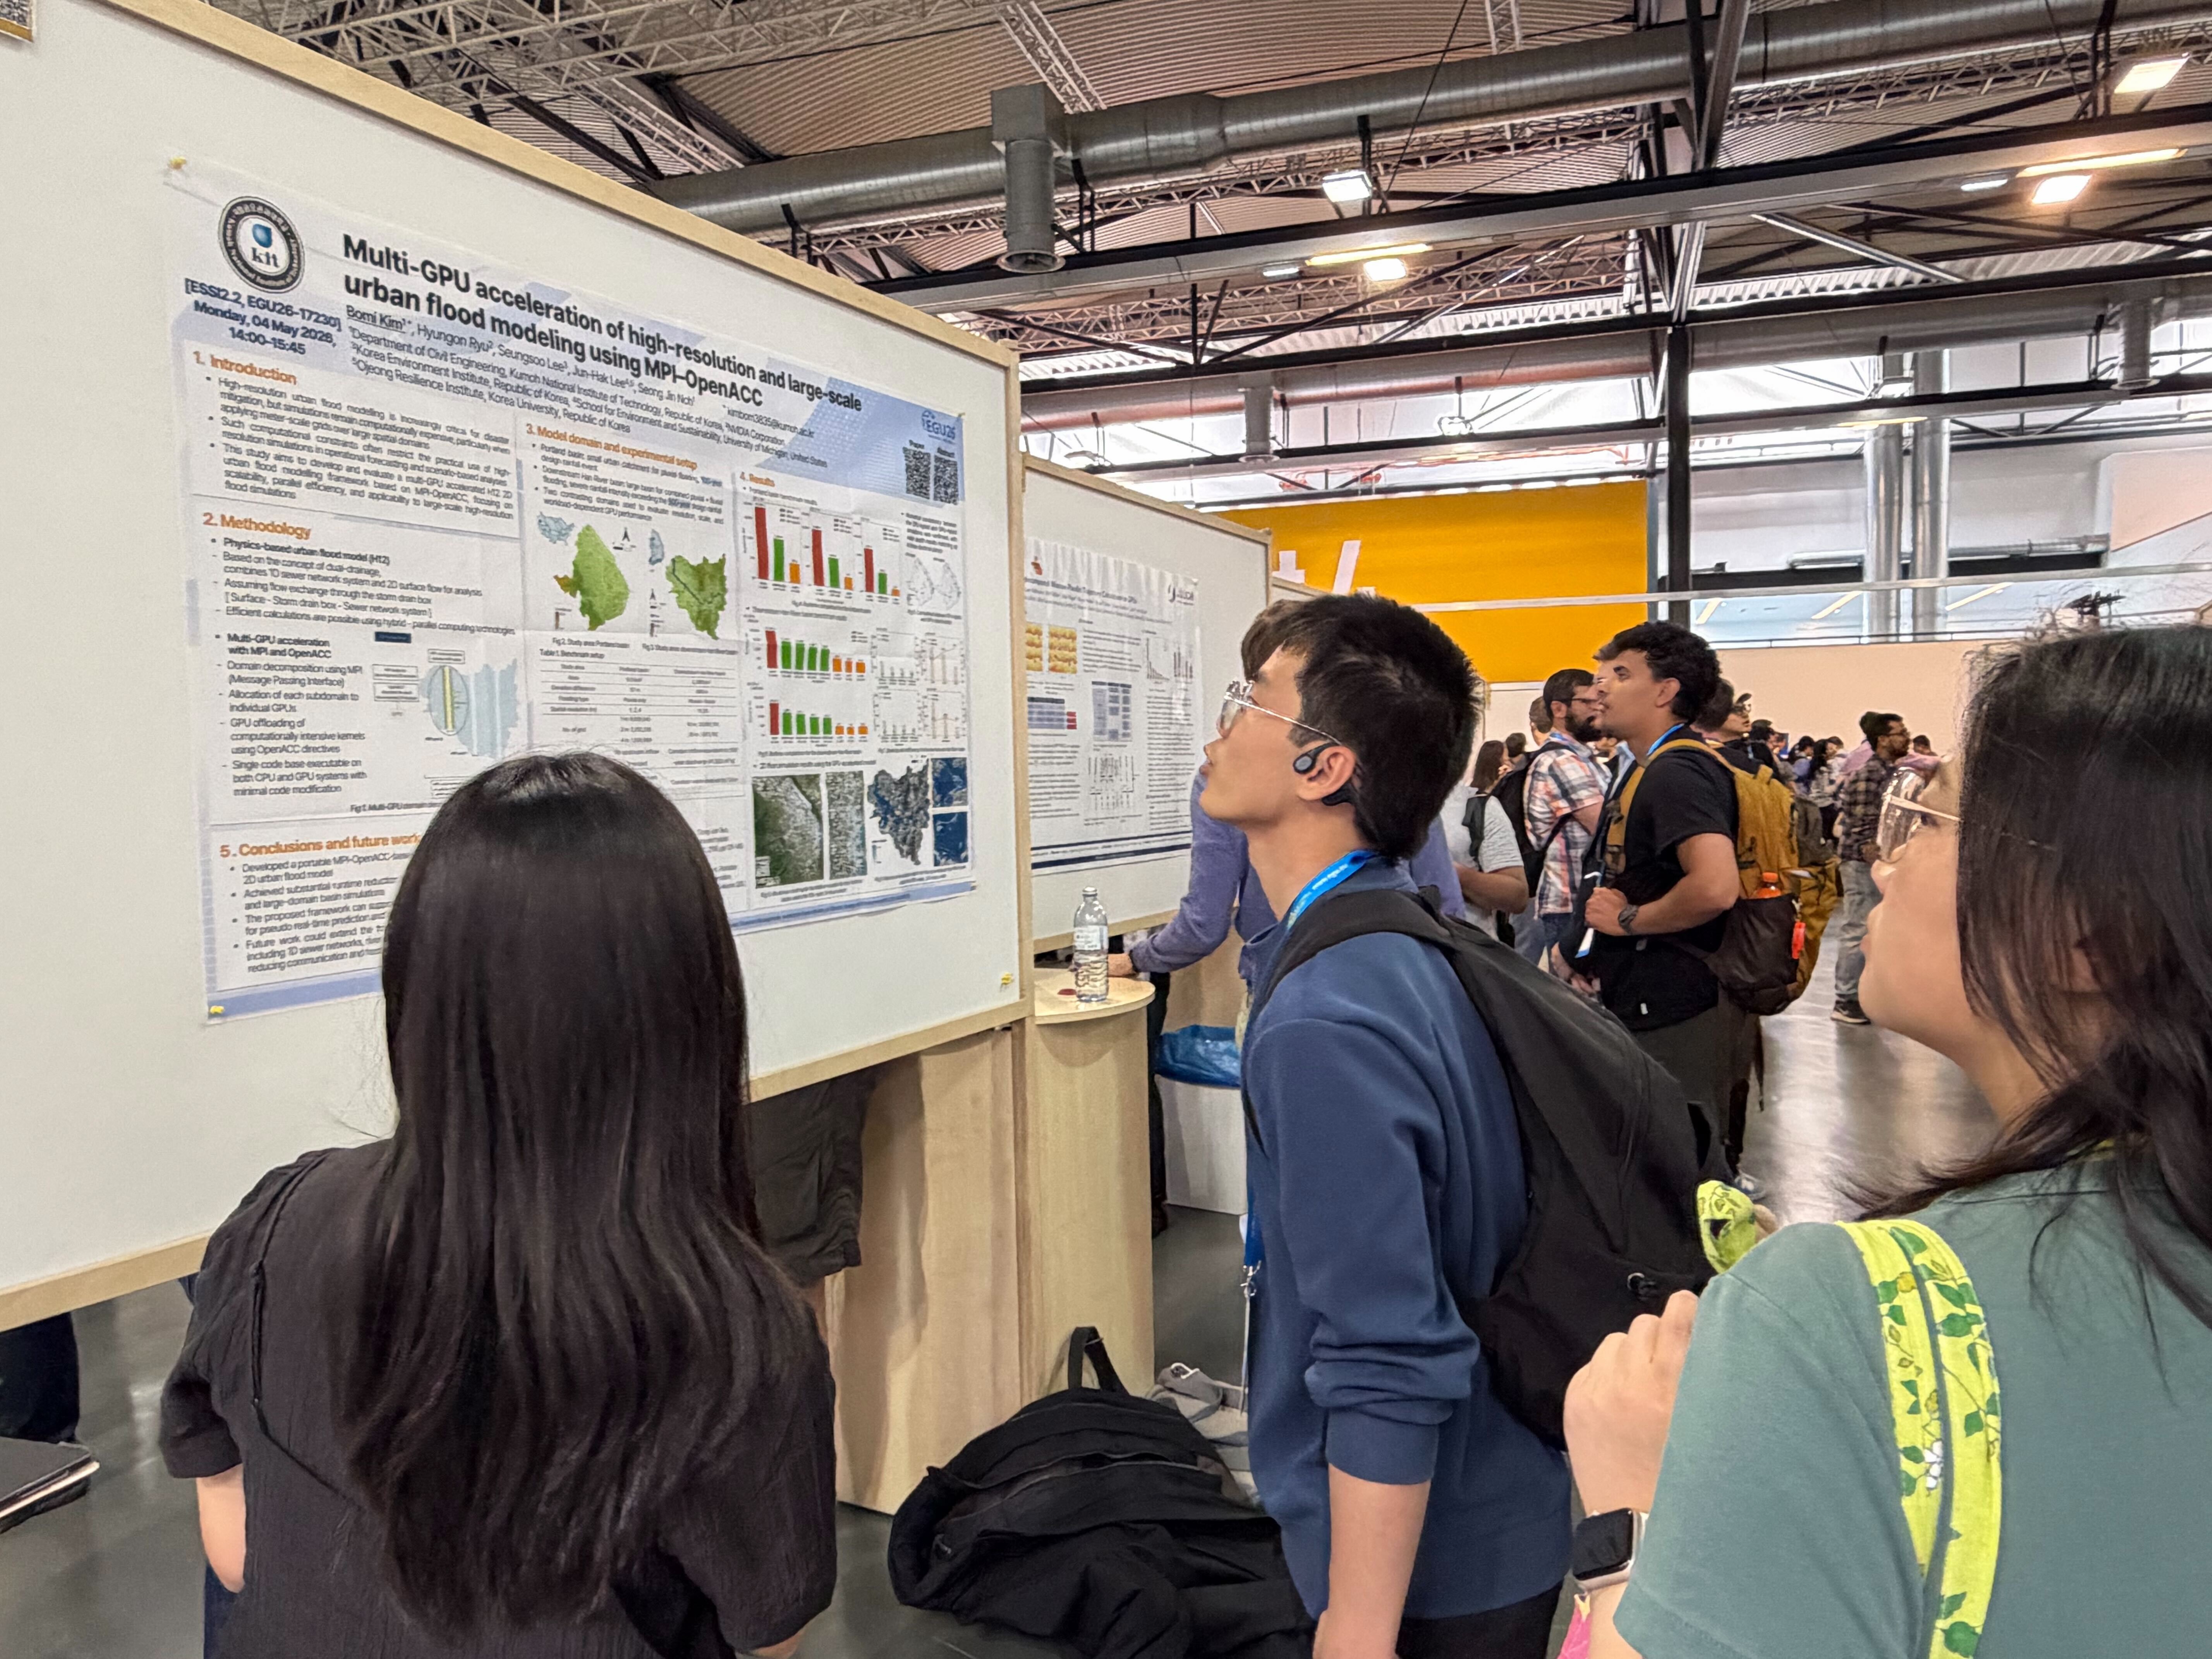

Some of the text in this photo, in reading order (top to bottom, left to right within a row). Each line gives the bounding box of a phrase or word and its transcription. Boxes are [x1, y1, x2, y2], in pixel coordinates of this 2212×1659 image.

[194, 300, 250, 326] Monday,
[251, 314, 270, 329] 04
[271, 319, 299, 338] May
[247, 295, 341, 332] EGU26-17230]
[343, 235, 862, 411] Multi-GPU acceleration of high-resolution and large-scale
[345, 275, 420, 311] urban
[426, 292, 485, 329] flood
[491, 317, 586, 362] modeling
[589, 345, 641, 378] using
[229, 327, 306, 354] 14:00-15:45
[346, 304, 378, 327] Bomi
[417, 324, 467, 346] Hyungon
[497, 343, 545, 367] Seungsoo
[572, 365, 609, 384] Jun-Hak
[637, 382, 663, 401] Seong
[665, 390, 676, 402] Jin
[192, 350, 296, 384] 1. Introduction
[386, 352, 450, 377] Environment
[452, 368, 492, 389] Institute,
[493, 378, 532, 397] Republic
[533, 388, 543, 398] of
[604, 404, 615, 416] for
[616, 407, 662, 428] Environment
[662, 421, 677, 431] and
[723, 434, 753, 450] University
[754, 443, 761, 452] of
[395, 369, 443, 391] Resilience
[445, 381, 486, 402] Institute,
[488, 391, 515, 407] Korea
[516, 397, 561, 419] University,
[562, 408, 597, 425] Republic
[598, 417, 607, 427] of
[608, 419, 630, 433] Korea
[414, 345, 426, 356] of
[426, 347, 448, 362] Civil
[450, 352, 507, 379] Engineering,
[509, 368, 541, 383] Kumoh
[542, 376, 575, 393] National
[577, 384, 608, 402] Institute
[609, 393, 618, 404] of
[619, 395, 663, 416] Technology,
[664, 407, 694, 423] Republic
[694, 416, 702, 424] of
[750, 429, 785, 445] Corporation
[222, 442, 242, 455] This
[246, 448, 271, 461] study
[537, 426, 568, 441] Model
[568, 433, 603, 448] domain
[603, 442, 620, 453] and
[621, 446, 675, 464] experimental
[202, 512, 310, 540] 2. Methodology
[227, 633, 330, 647] Multi-GPU acceleration
[228, 646, 331, 659] with MPI and OpenACC
[227, 660, 362, 676] Domain decomposition using MPI
[228, 674, 345, 688] (Message Passing Interface)
[228, 689, 359, 701] Allocation of each subdomain to
[229, 702, 297, 713] individual GPUs
[230, 718, 306, 730] GPU offloading of
[230, 732, 365, 742] computationally intensive kernels
[231, 744, 340, 757] using OpenACC directives
[232, 759, 259, 771] Single
[260, 759, 283, 769] code
[284, 760, 306, 768] base
[306, 759, 350, 768] executable
[232, 771, 367, 783] both CPU and GPU systems with
[233, 784, 342, 796] minimal code modification
[239, 840, 323, 856] Conclusions
[325, 836, 351, 850] and
[352, 836, 389, 848] future
[242, 858, 331, 872] Developed a portable
[257, 874, 283, 883] urban
[283, 871, 306, 881] flood
[307, 869, 333, 878] model
[245, 914, 263, 923] The
[264, 910, 306, 923] proposed
[307, 905, 350, 916] framework
[245, 939, 275, 949] Future
[279, 935, 301, 945] work
[303, 931, 326, 942] could
